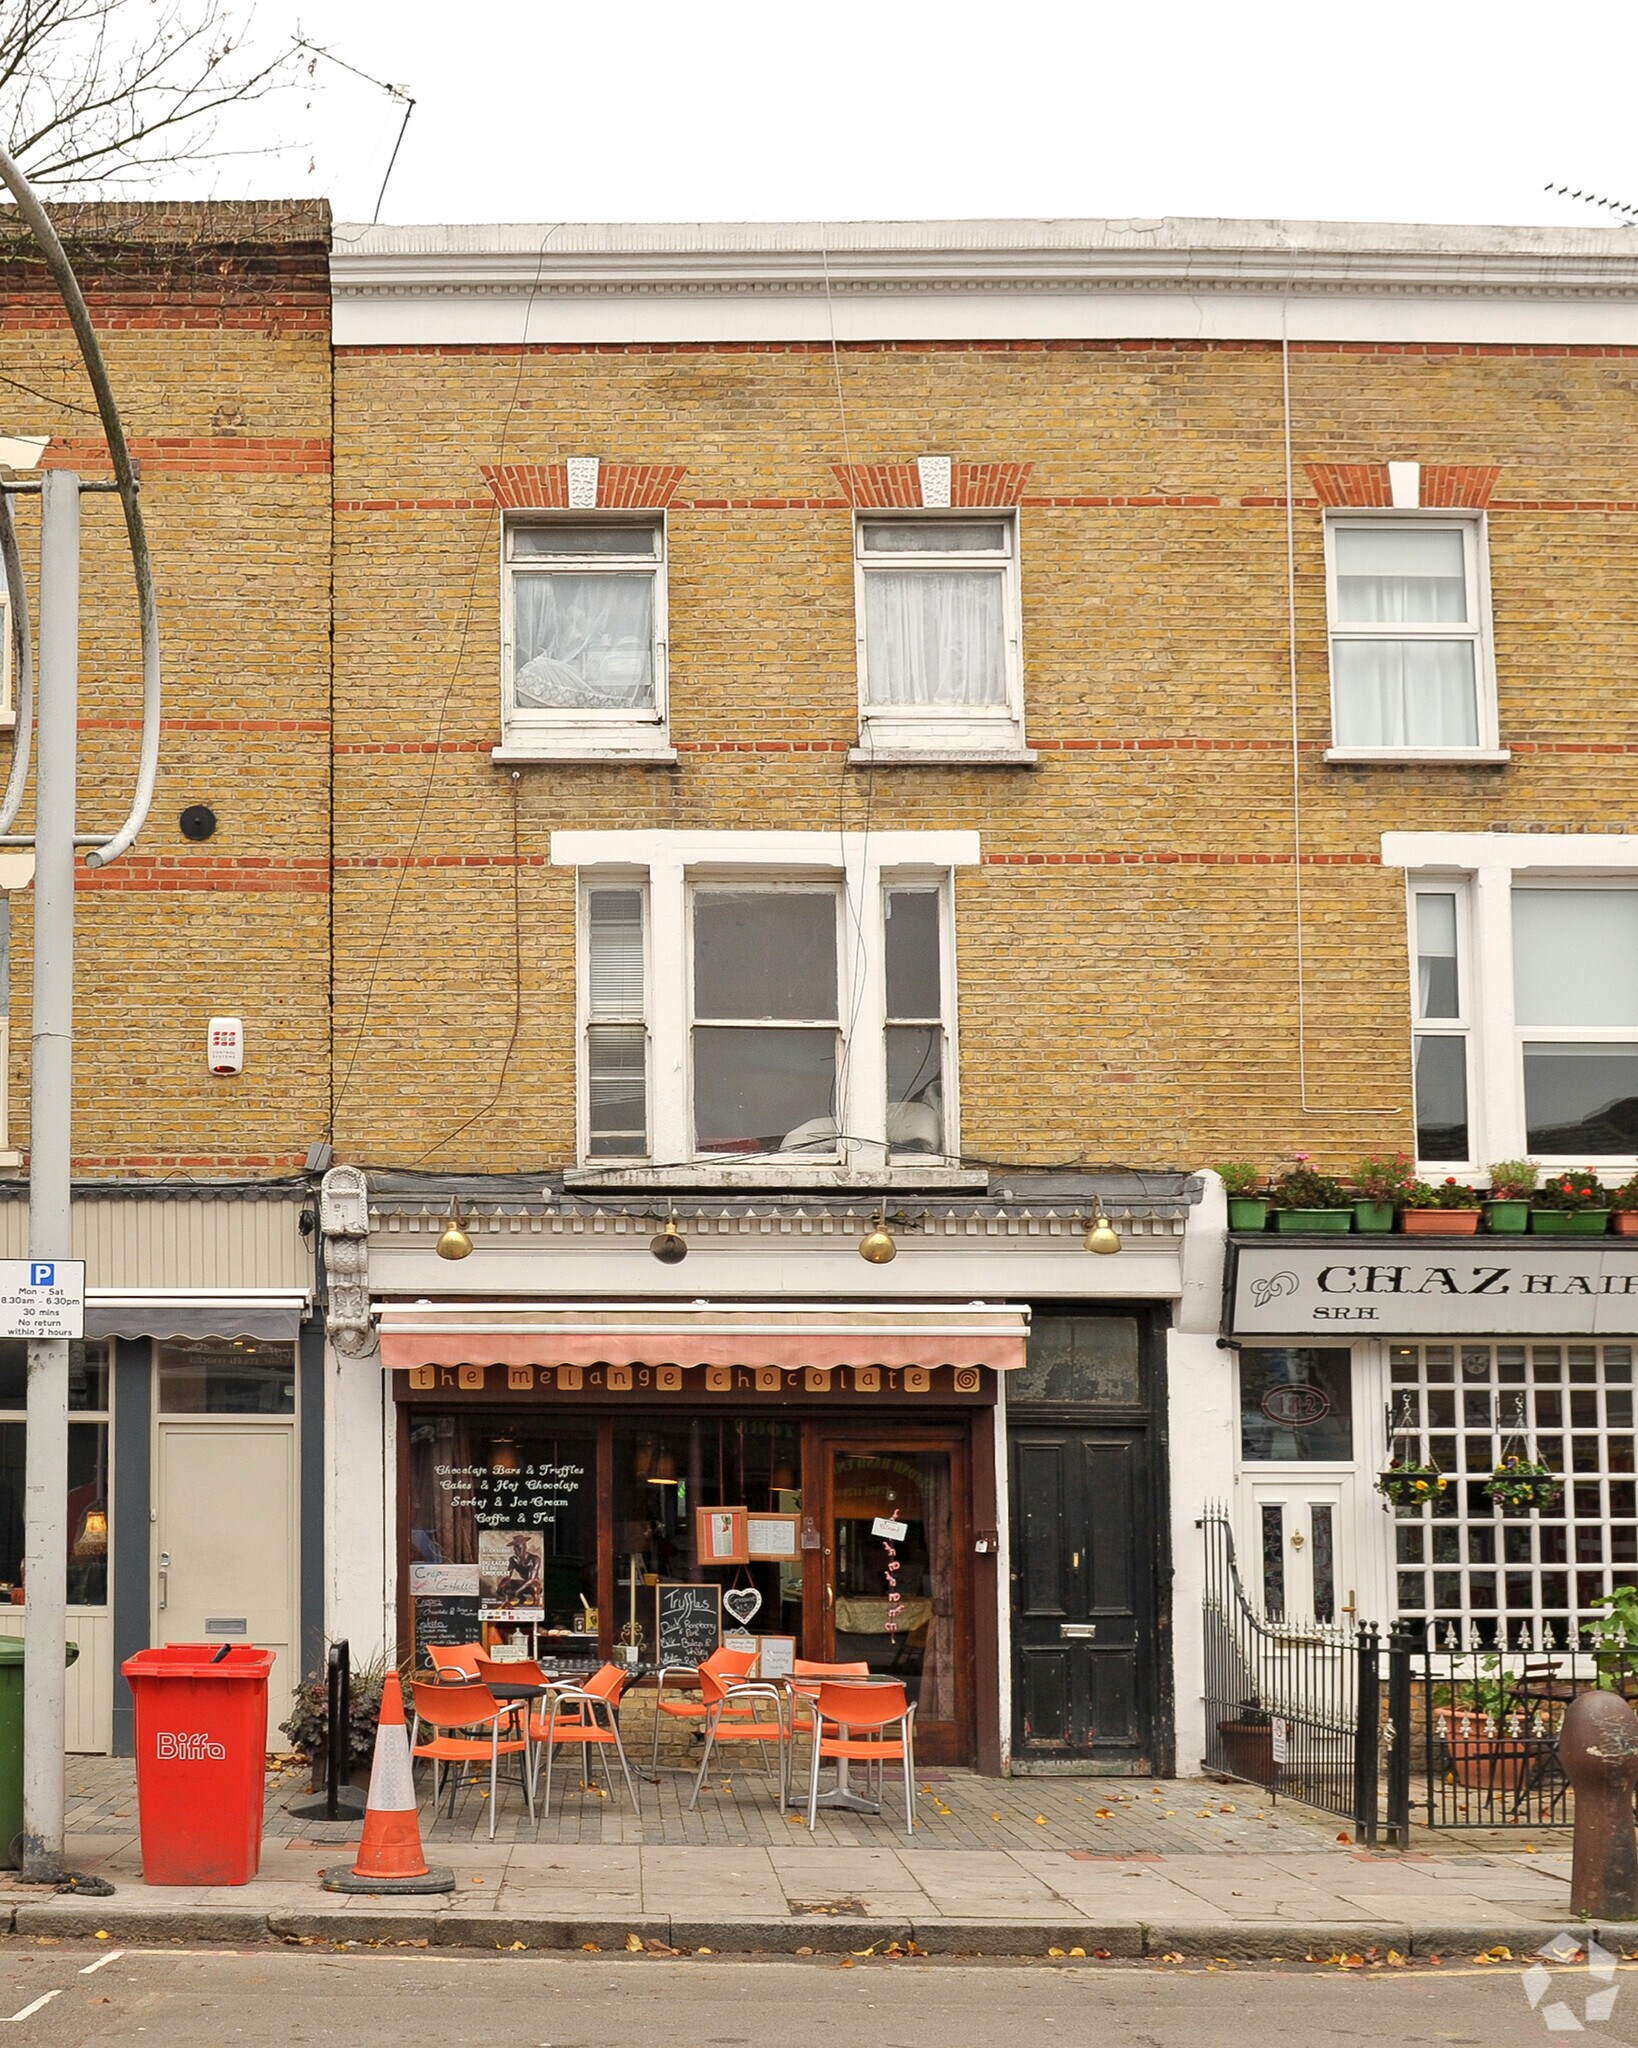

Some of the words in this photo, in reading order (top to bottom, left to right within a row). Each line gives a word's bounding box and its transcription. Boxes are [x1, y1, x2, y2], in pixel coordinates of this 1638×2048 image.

[35, 1265, 52, 1285] P
[1316, 1265, 1512, 1294] CHAZ
[1, 1296, 35, 1304] 8.30am
[46, 1297, 80, 1306] 6.30pm
[23, 1308, 36, 1316] 30
[1312, 1306, 1380, 1320] SRH
[34, 1319, 62, 1327] return
[48, 1328, 73, 1336] hours
[416, 1369, 478, 1387] the
[511, 1368, 676, 1387] melange
[711, 1369, 924, 1389] chocolate
[434, 1465, 487, 1477] Chocolate
[492, 1465, 521, 1475] Bars
[526, 1465, 535, 1475] &
[539, 1464, 584, 1477] Truffles
[440, 1480, 472, 1490] Cakes
[480, 1480, 489, 1490] &
[493, 1480, 519, 1492] Hot
[525, 1480, 579, 1492] Chocolate
[450, 1496, 487, 1509] Sorbet
[494, 1496, 503, 1507] &
[474, 1512, 510, 1526] Coffee
[517, 1512, 526, 1523] &
[533, 1511, 555, 1524] Tea
[664, 1588, 710, 1618] Truffles
[157, 1732, 226, 1760] Biffa
